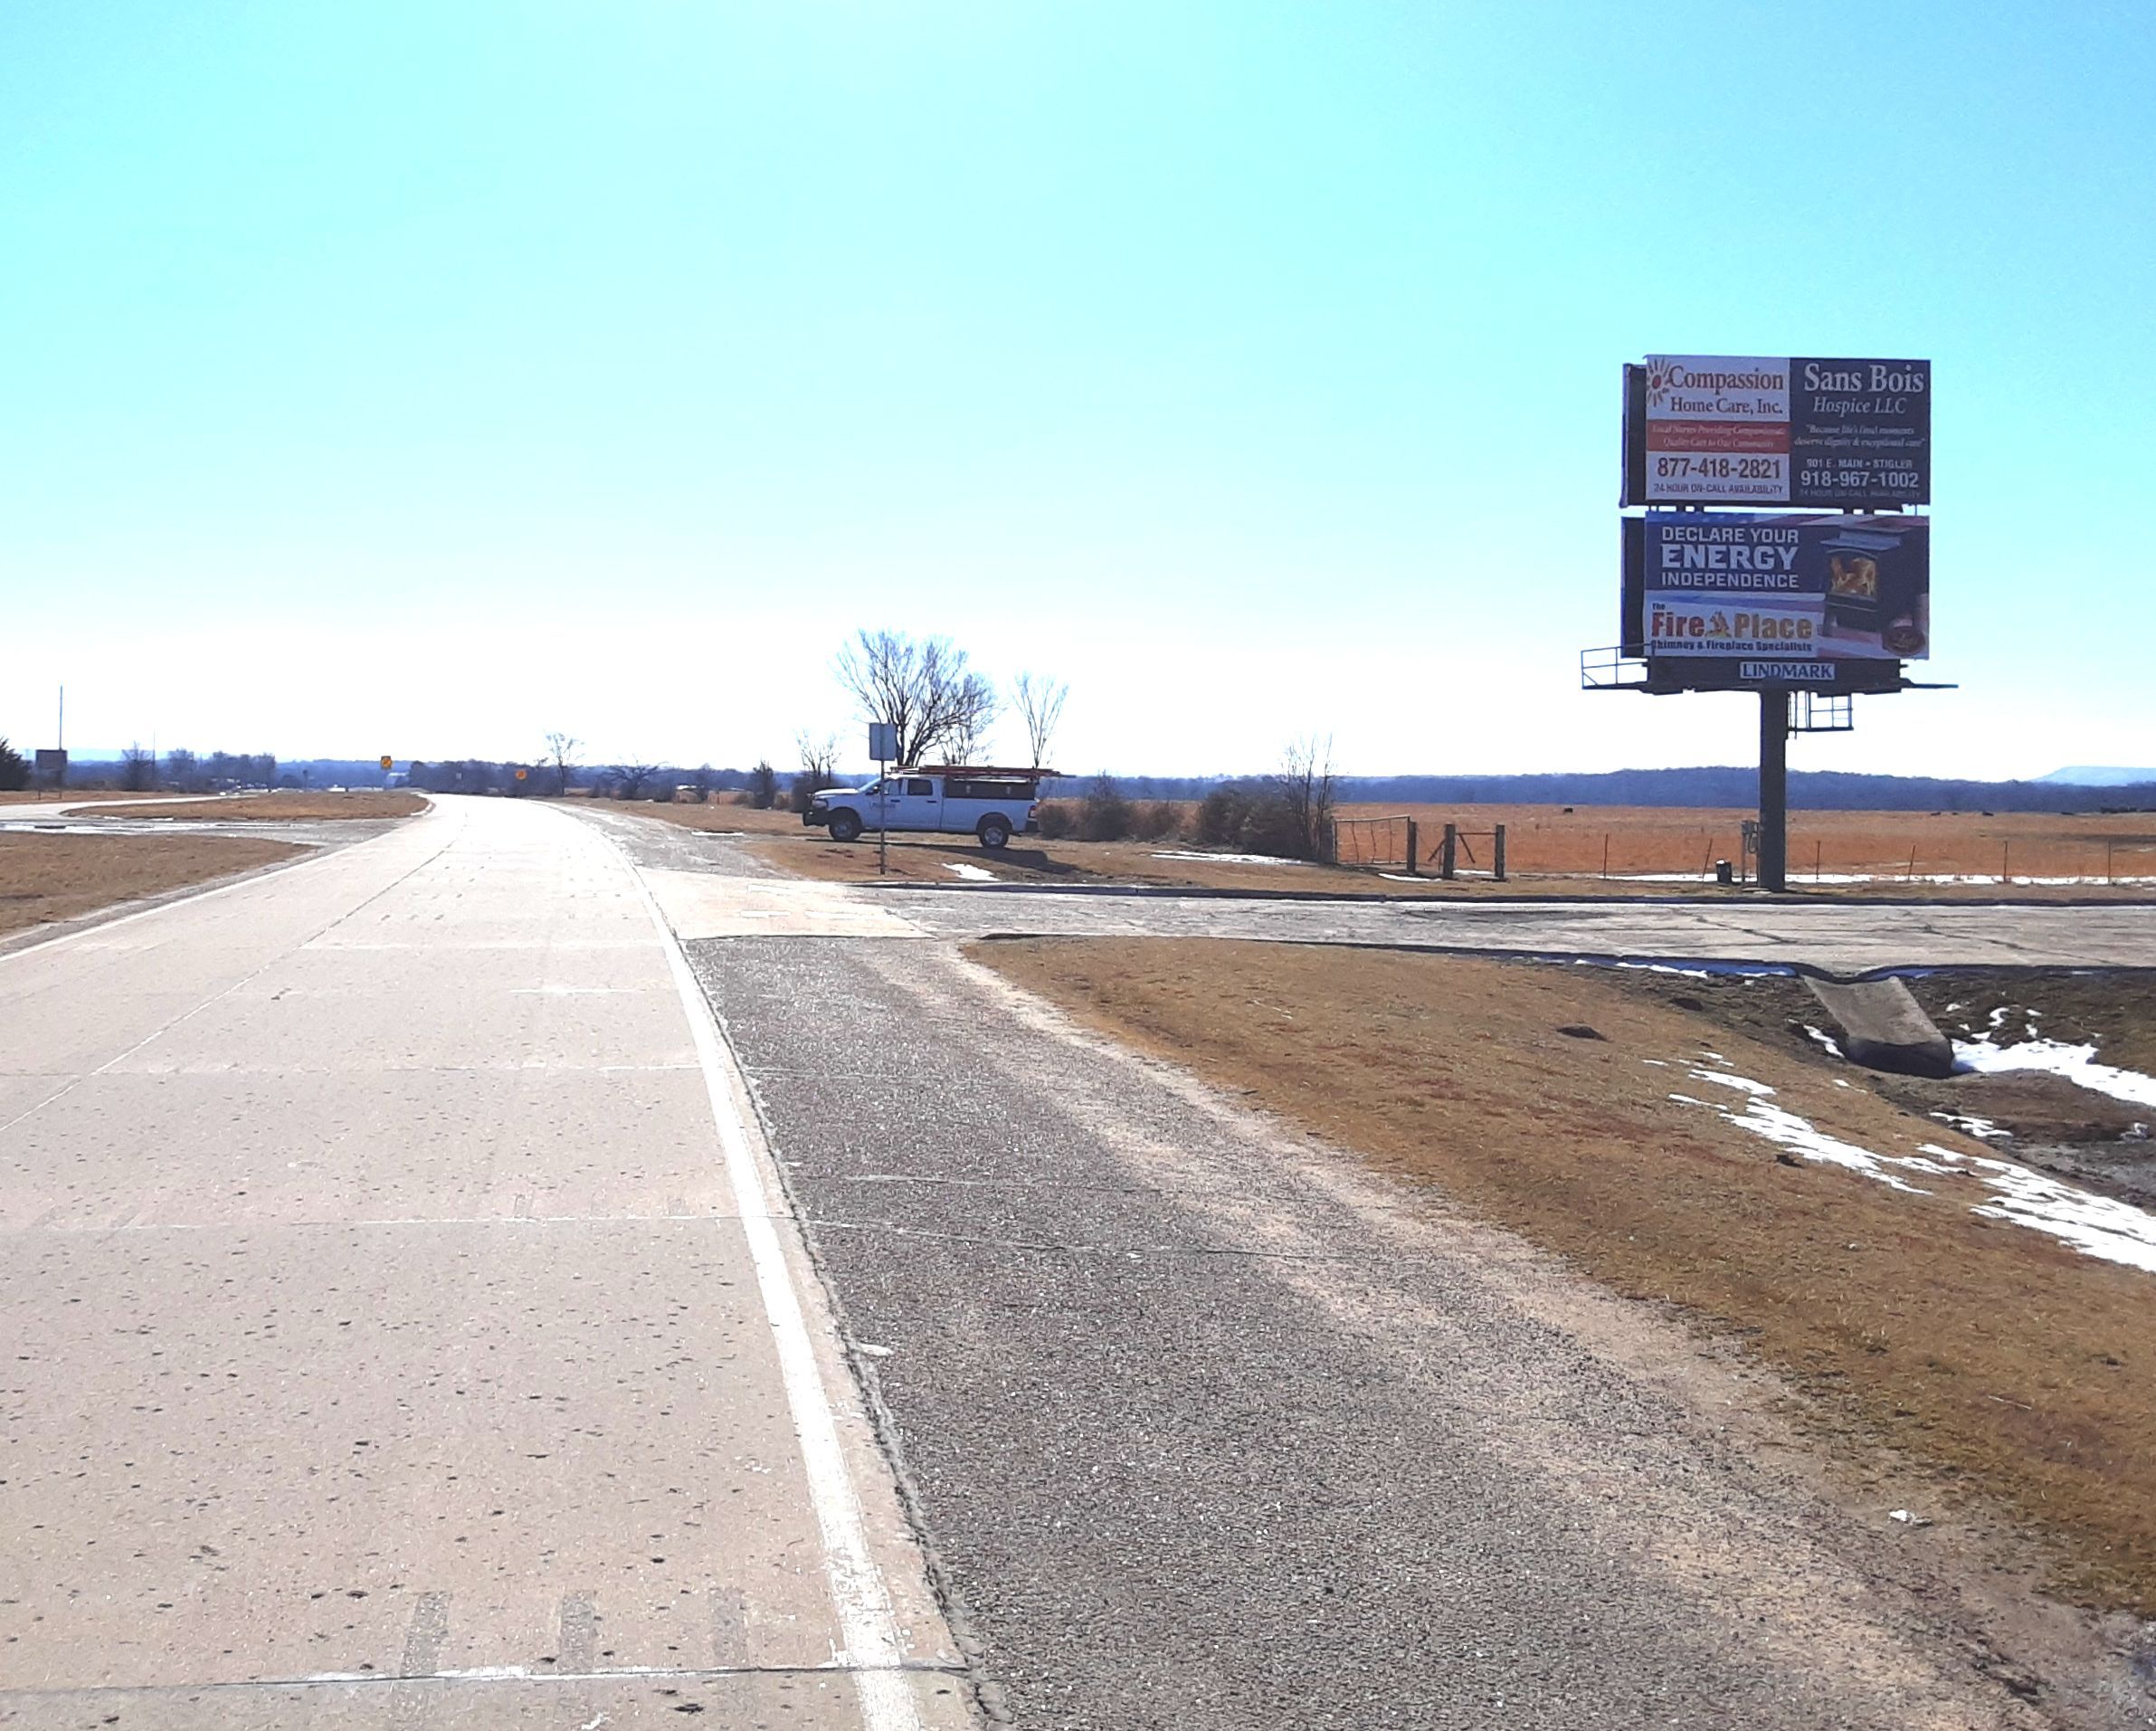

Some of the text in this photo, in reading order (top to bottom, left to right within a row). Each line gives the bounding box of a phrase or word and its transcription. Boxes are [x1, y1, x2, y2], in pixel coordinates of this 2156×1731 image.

[1668, 365, 1783, 395] Compassion
[1804, 363, 1923, 393] Sans Bois
[1670, 396, 1783, 415] Home Care, Inc.
[1813, 396, 1908, 418] Hospice LLC
[1657, 457, 1781, 479] 877-418-2821
[1806, 459, 1823, 468] 901
[1838, 459, 1863, 469] MAIN
[1873, 460, 1913, 470] STIGLER
[1654, 483, 1783, 495] 24 HOUR ON-CALL AVAILABILITY
[1800, 470, 1919, 489] 918-967-1002
[1661, 526, 1800, 544] DECLARE YOUR
[1660, 543, 1800, 571] ENERGY
[1661, 572, 1800, 589] INDEPENDENCE
[1651, 611, 1812, 639] Fire Place
[1651, 640, 1812, 652] Chimney & Fireplace Specialists
[1743, 662, 1832, 679] LINDMARK
